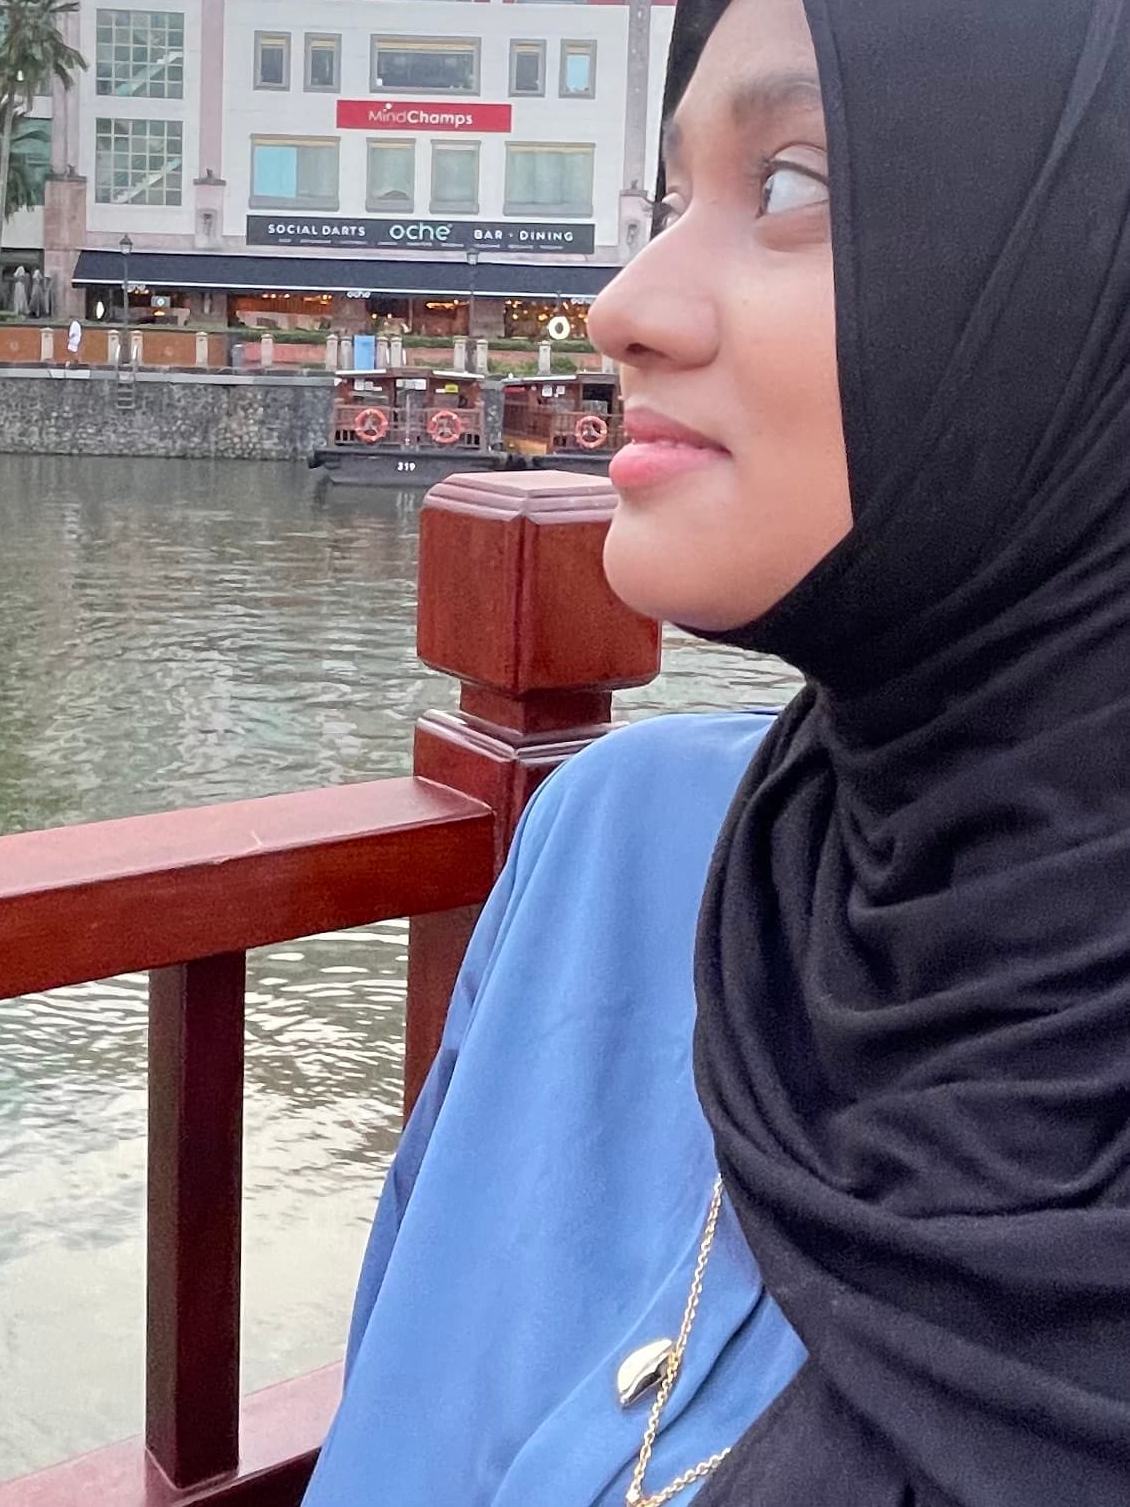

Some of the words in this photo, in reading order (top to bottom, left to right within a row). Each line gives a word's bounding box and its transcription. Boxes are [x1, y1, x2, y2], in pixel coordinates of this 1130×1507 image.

[368, 102, 473, 129] MindChamps
[268, 223, 318, 236] SOCIAL
[322, 225, 366, 237] DARTS
[389, 222, 451, 241] oche
[474, 229, 503, 241] BAR
[519, 229, 574, 242] DINING
[397, 461, 416, 472] 319
